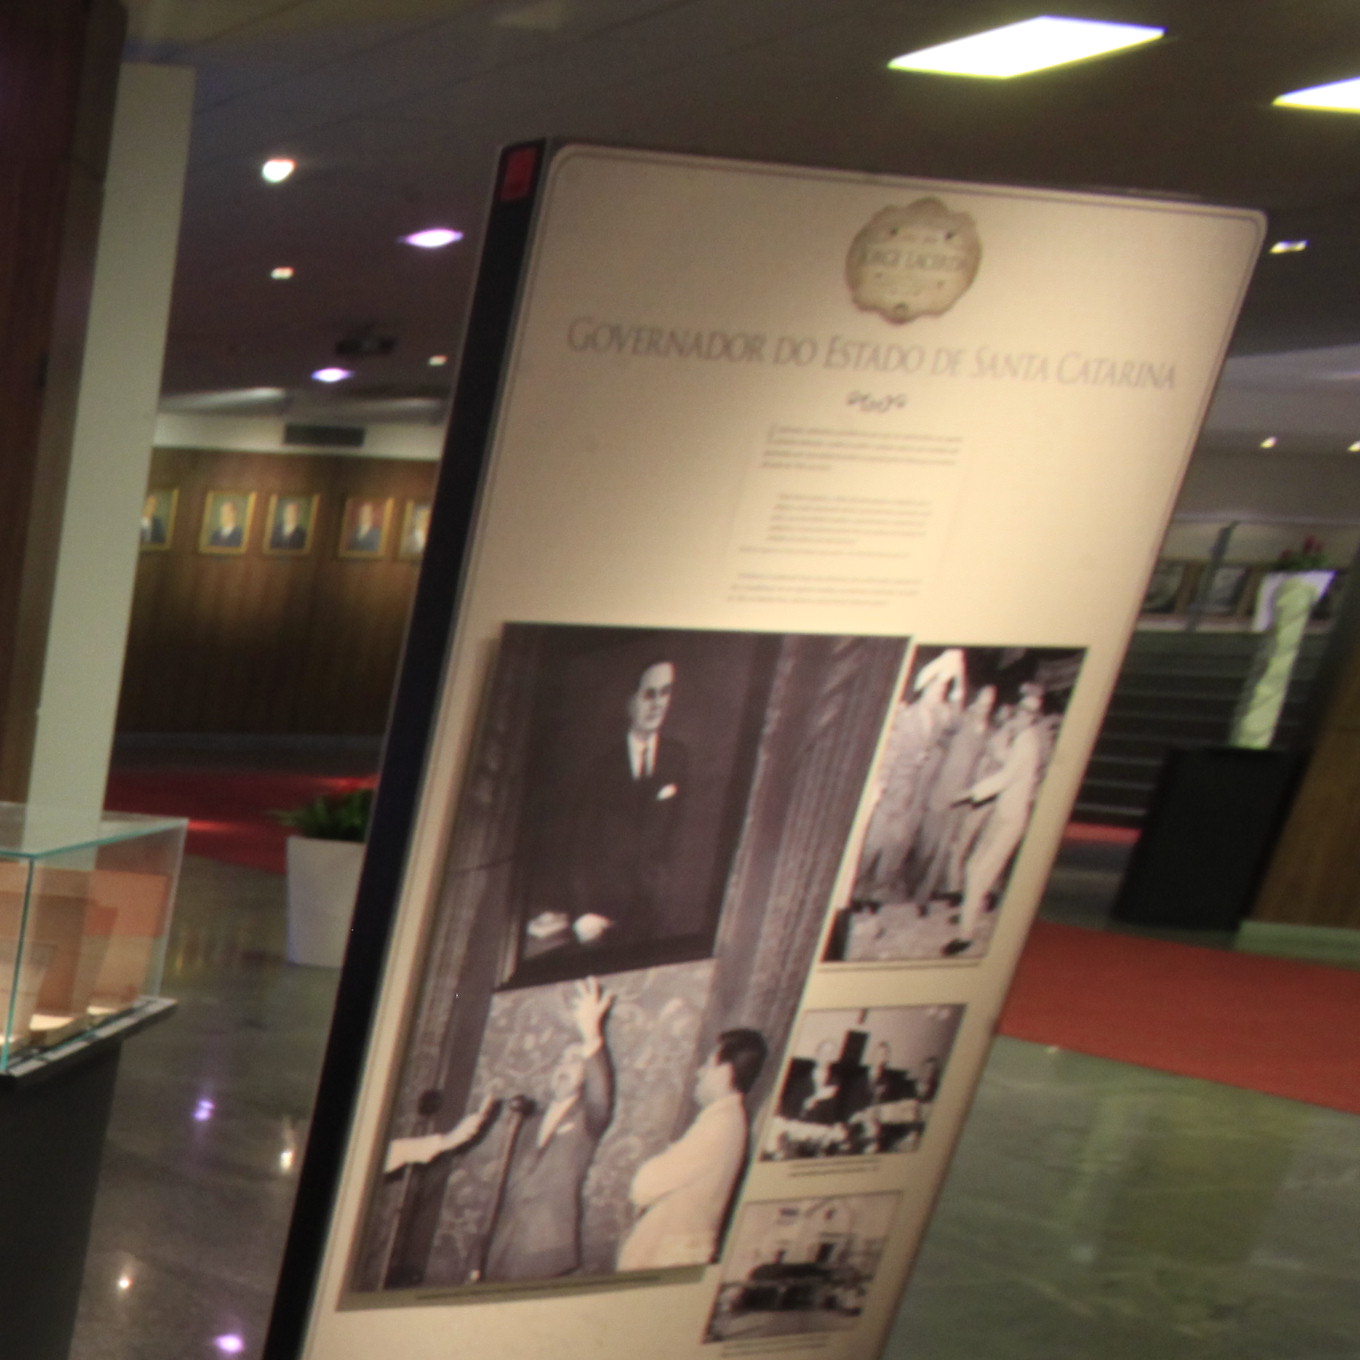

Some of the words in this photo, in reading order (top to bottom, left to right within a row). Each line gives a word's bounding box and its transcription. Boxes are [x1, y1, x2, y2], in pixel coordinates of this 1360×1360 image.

[566, 316, 765, 364] GOVERNADOR
[778, 335, 818, 368] DO
[823, 333, 926, 375] ESTADO
[930, 346, 965, 379] DE
[972, 345, 1049, 385] SANTA
[1056, 350, 1177, 391] CATARINA
